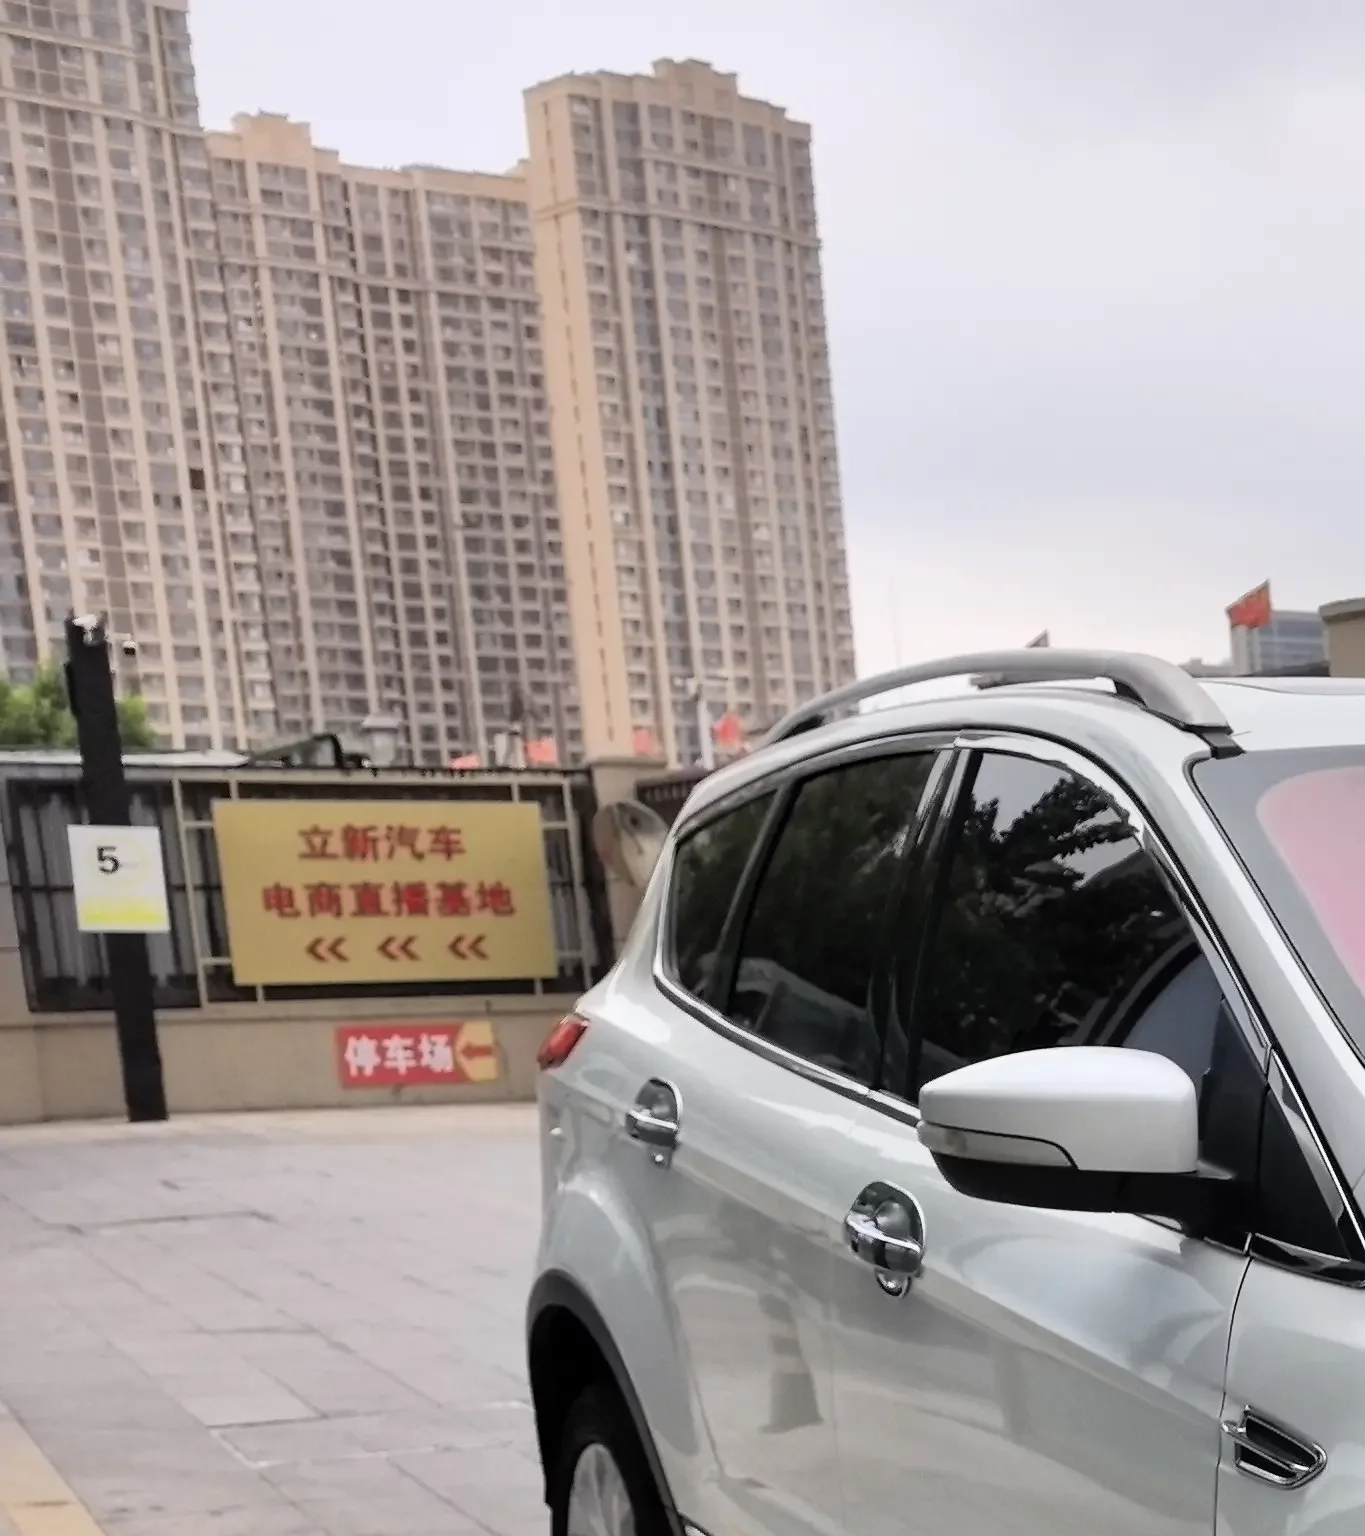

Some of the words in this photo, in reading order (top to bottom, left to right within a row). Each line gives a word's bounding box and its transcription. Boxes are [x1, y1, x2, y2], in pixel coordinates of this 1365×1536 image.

[96, 845, 121, 875] 5
[298, 824, 467, 862] 立新汽车
[262, 880, 517, 919] 电商直播基地
[344, 1033, 454, 1078] 停车场
